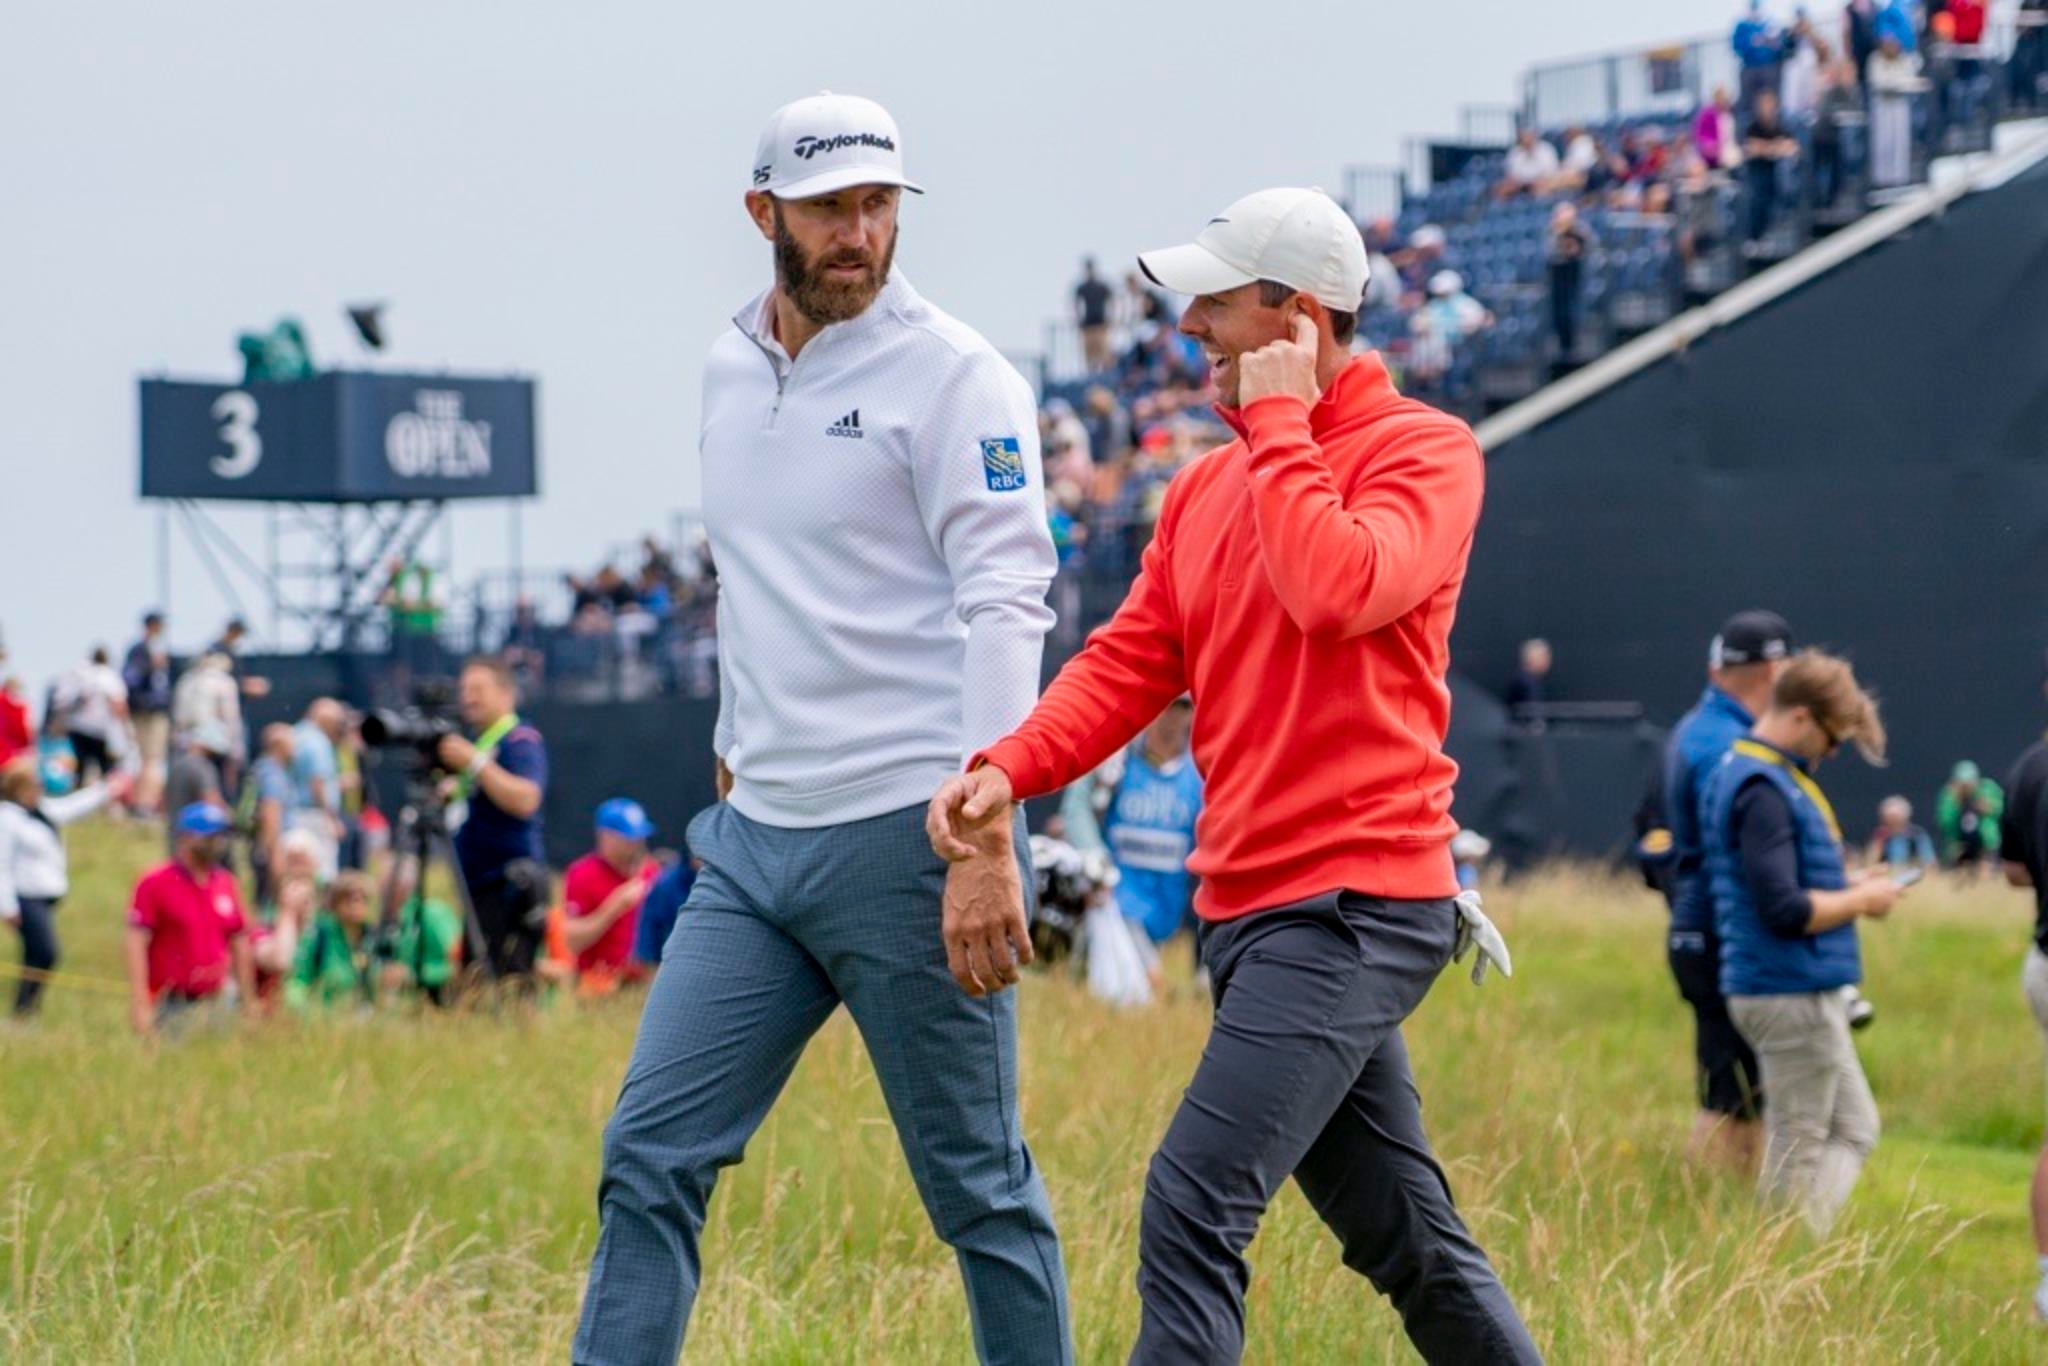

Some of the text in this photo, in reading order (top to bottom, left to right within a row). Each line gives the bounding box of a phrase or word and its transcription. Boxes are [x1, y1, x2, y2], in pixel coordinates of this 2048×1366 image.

[794, 134, 895, 160] TaylorMade
[416, 389, 464, 417] THE
[209, 390, 263, 479] 3
[385, 411, 492, 478] OPEN
[825, 426, 864, 438] adidas
[991, 473, 1025, 489] RBC
